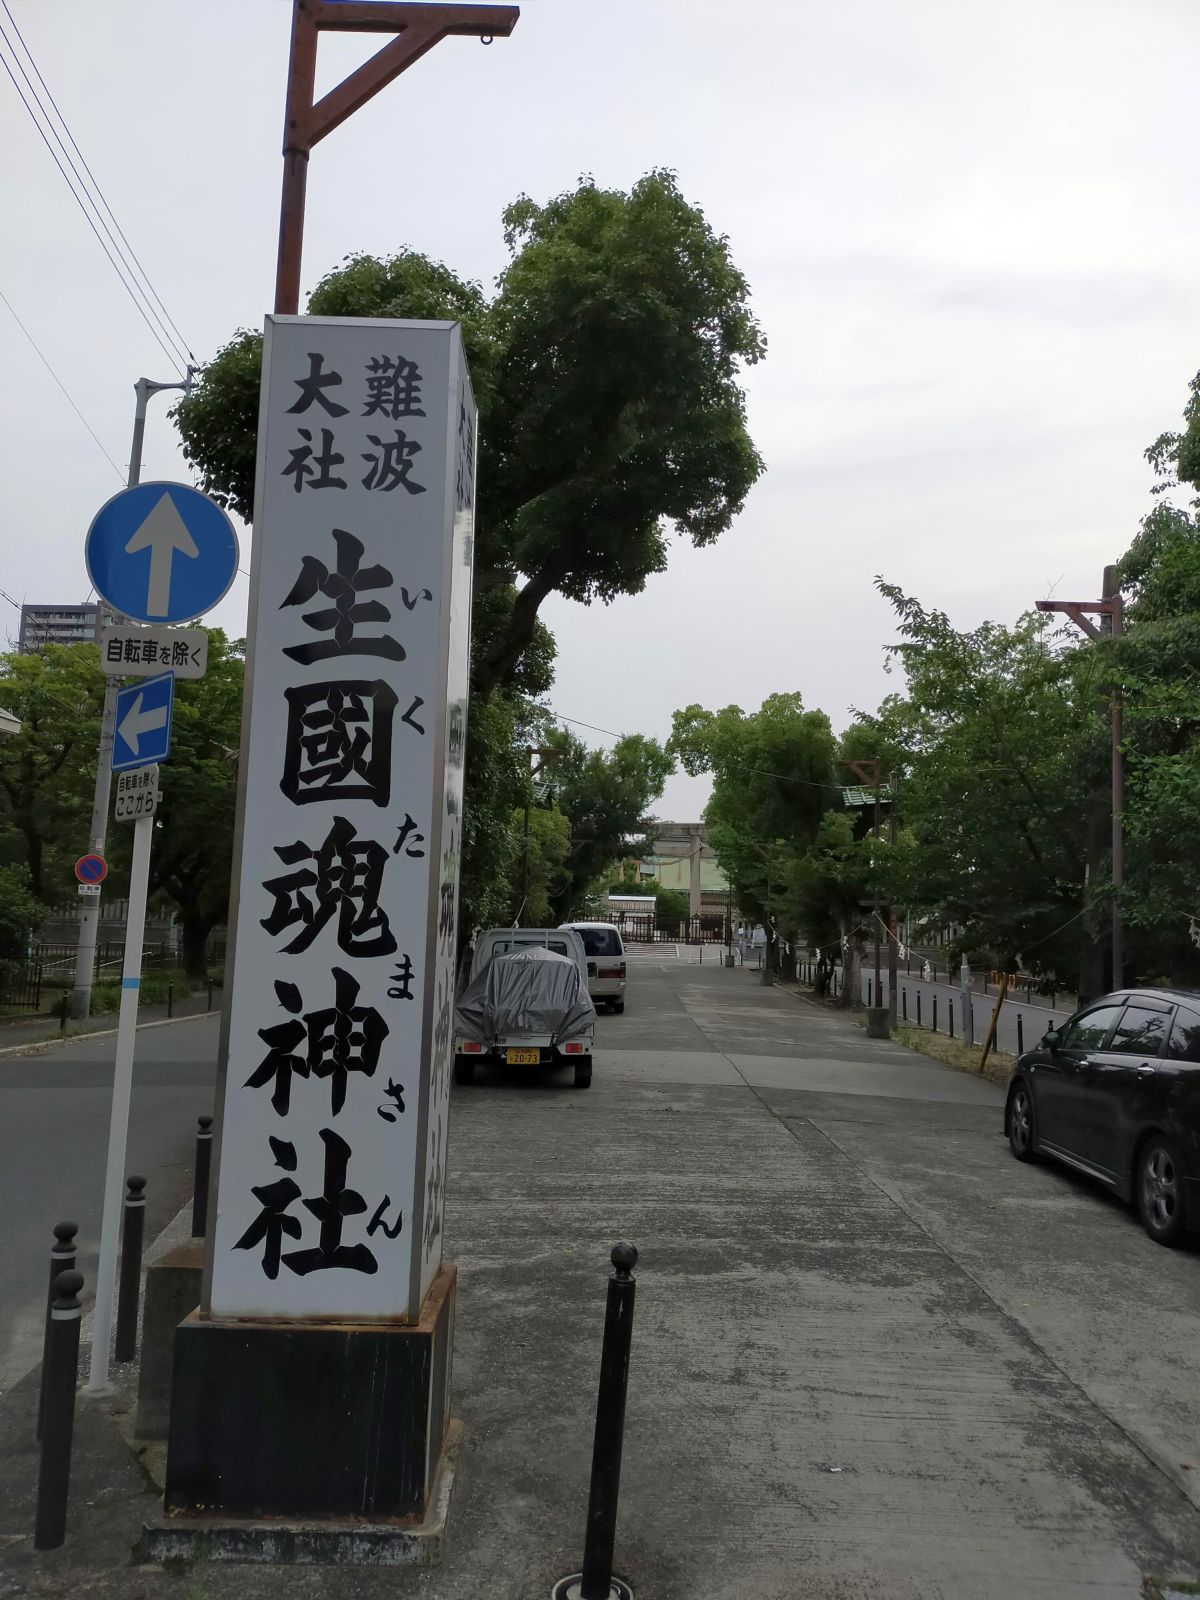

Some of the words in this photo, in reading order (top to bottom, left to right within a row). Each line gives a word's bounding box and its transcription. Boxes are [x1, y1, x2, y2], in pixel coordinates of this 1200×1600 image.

[281, 352, 351, 494] 大社
[360, 354, 428, 496] 難波
[107, 637, 201, 667] 自転車を除く
[117, 792, 154, 816] ここから
[119, 772, 154, 792] 自転車を除く
[230, 528, 407, 1281] 生國魂神社
